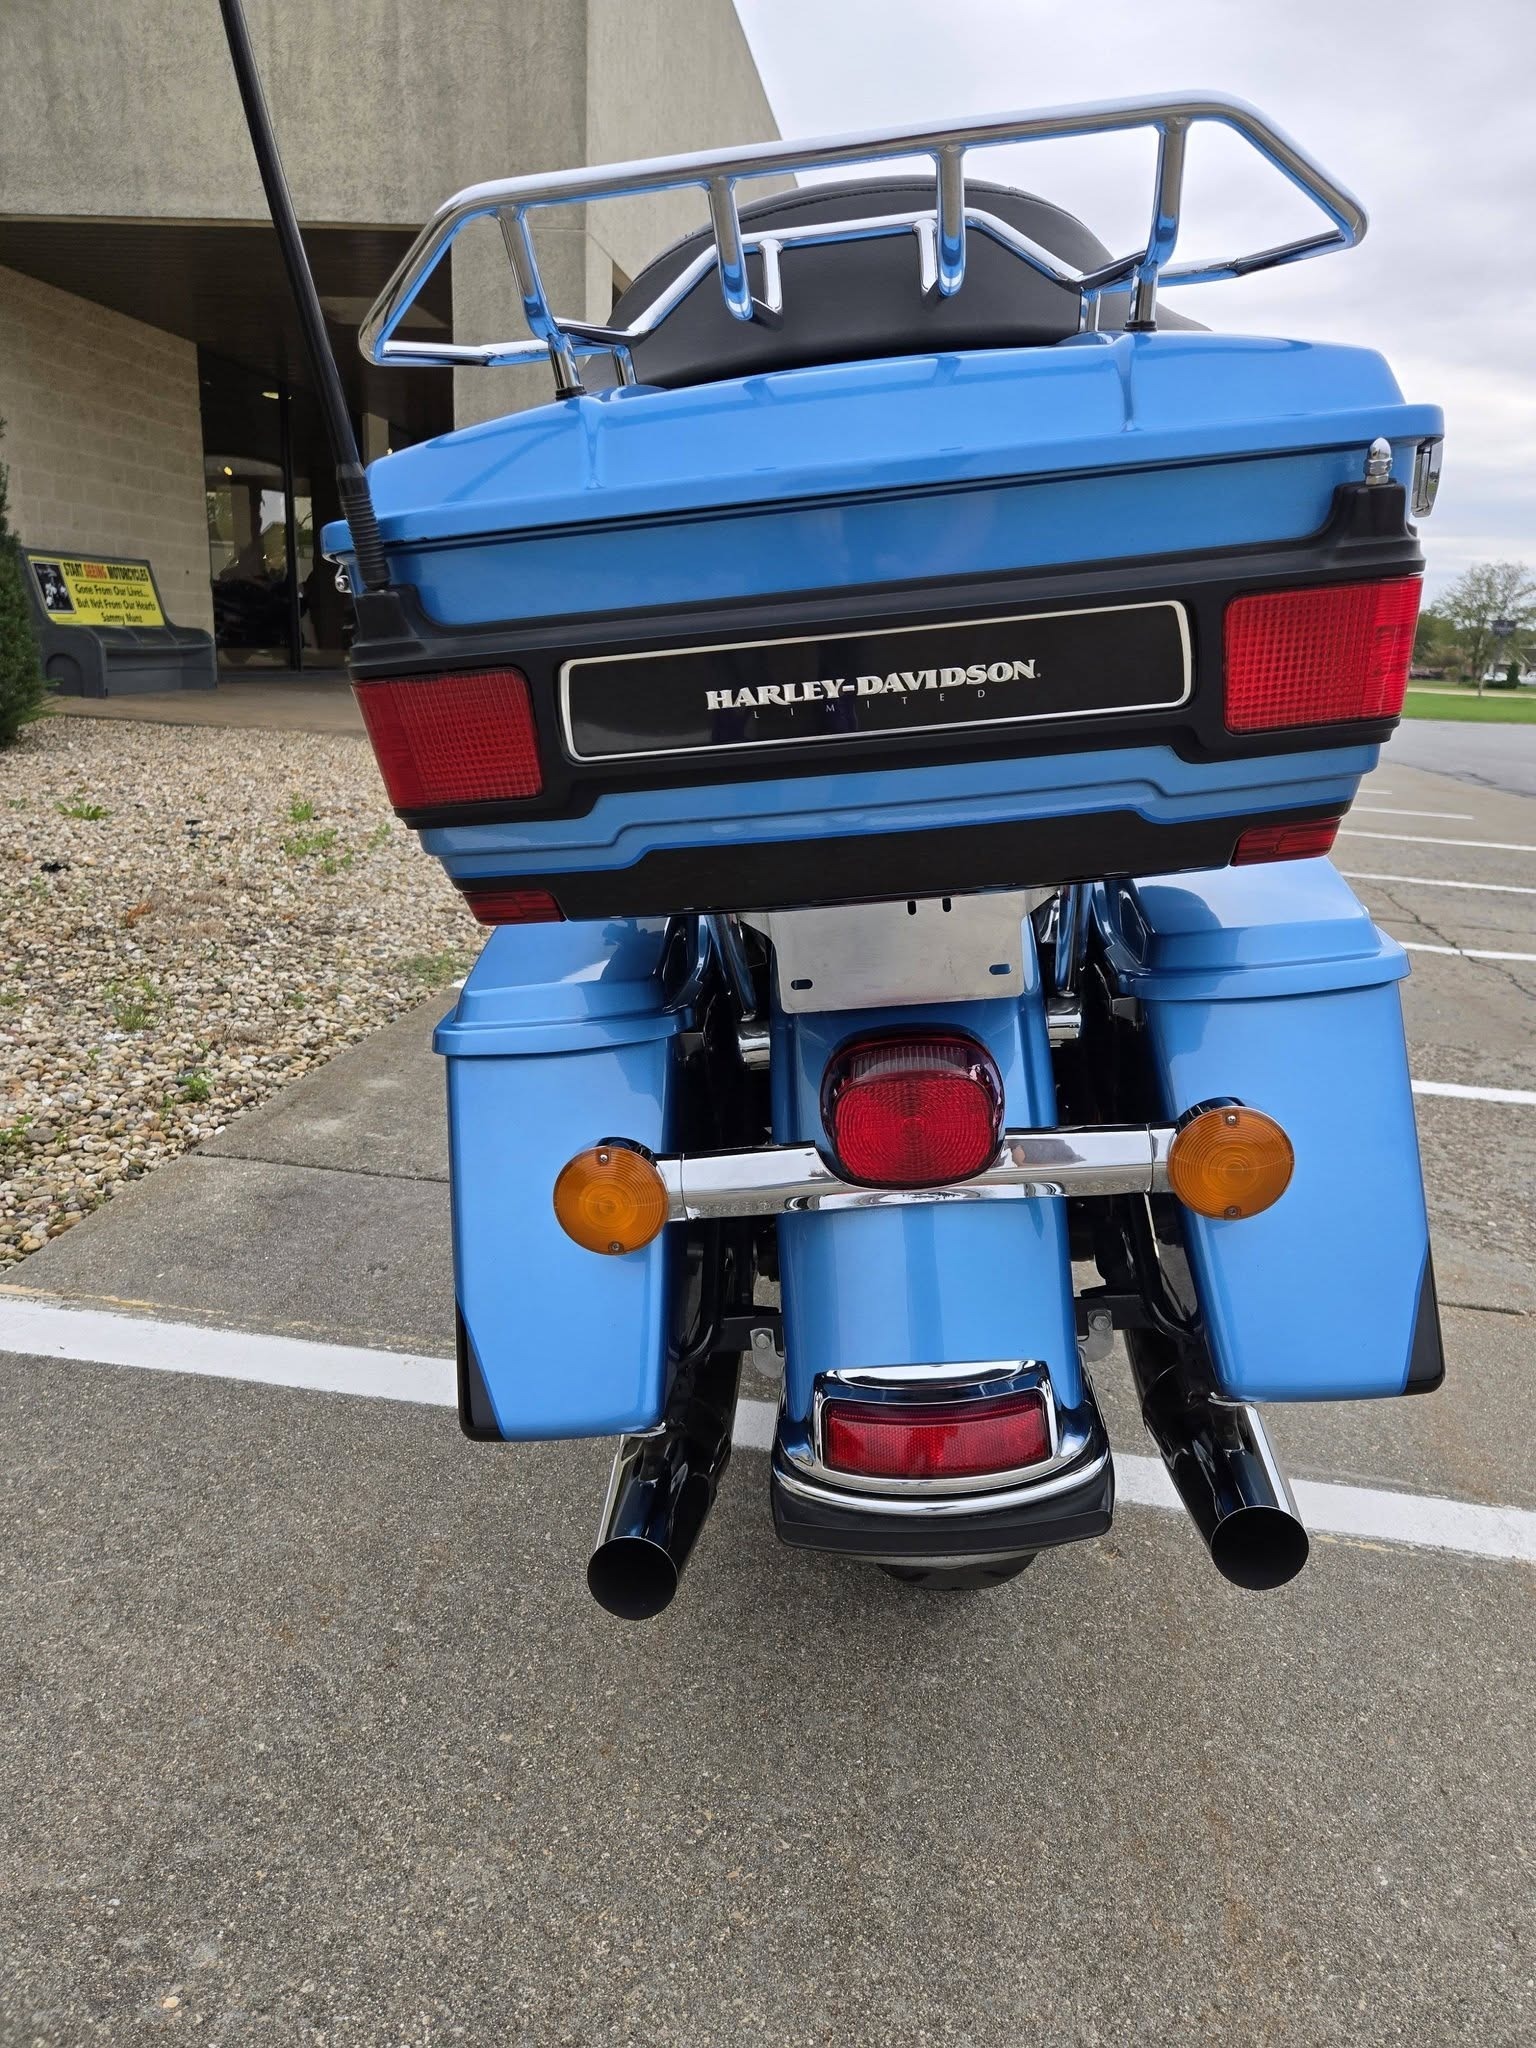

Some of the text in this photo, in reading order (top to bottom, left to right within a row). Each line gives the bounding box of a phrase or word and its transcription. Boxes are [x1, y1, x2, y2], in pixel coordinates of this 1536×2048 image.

[62, 562, 149, 582] START SEEING MOTORCYCLES
[75, 583, 93, 594] Gone
[94, 584, 113, 595] From
[113, 586, 126, 596] Our
[75, 598, 156, 611] But Not From Our Hearts
[753, 689, 986, 720] LIMITED
